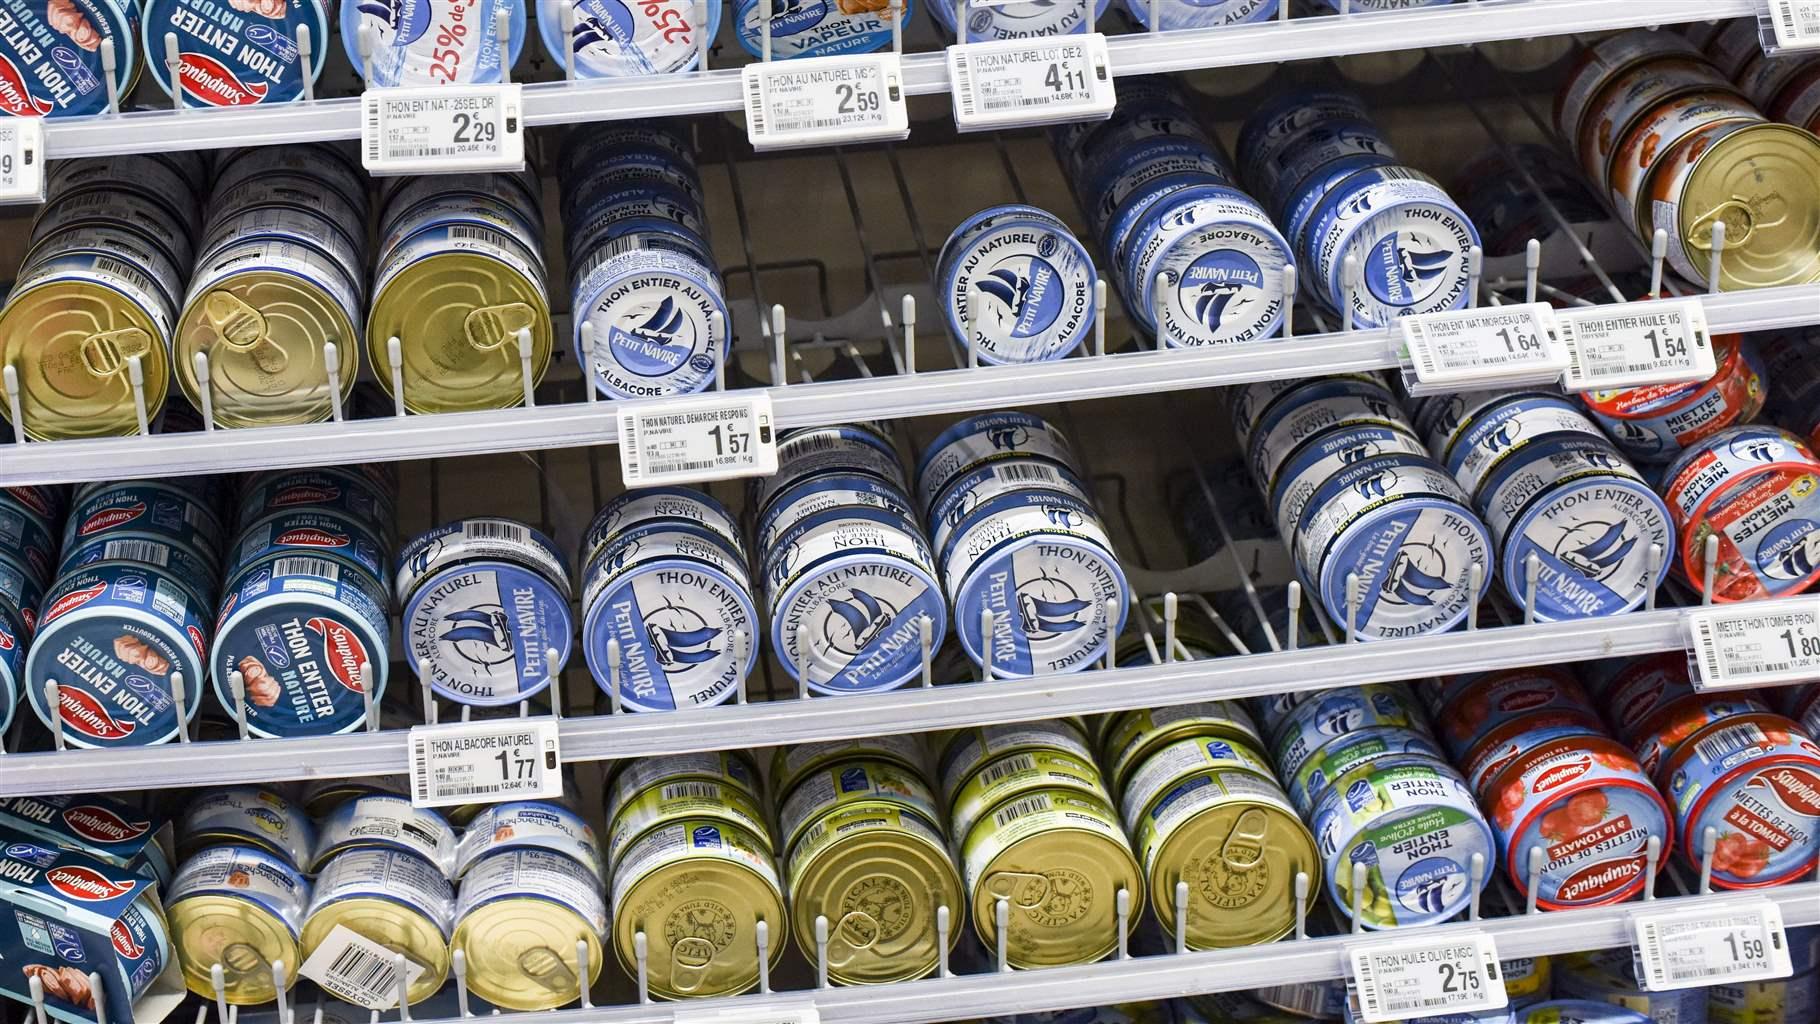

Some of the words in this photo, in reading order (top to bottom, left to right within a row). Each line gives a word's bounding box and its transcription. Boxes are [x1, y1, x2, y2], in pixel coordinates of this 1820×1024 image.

[783, 7, 823, 25] NAVIRE
[813, 18, 851, 34] THON
[170, 7, 241, 56] ENTIER
[791, 18, 882, 50] VAPEUR
[814, 34, 872, 57] NATURE
[237, 47, 286, 84] THON
[975, 56, 1000, 67] THON
[1001, 52, 1042, 64] NATUREL
[1062, 47, 1075, 59] DE
[34, 61, 76, 109] THON
[768, 75, 793, 87] THON
[796, 73, 808, 84] AU
[810, 70, 852, 83] NATUREL
[386, 101, 410, 113] THON
[482, 97, 495, 109] DR
[1199, 229, 1265, 245] ALBACORE
[1404, 208, 1441, 222] THON
[1441, 217, 1470, 254] ENTIER
[966, 256, 980, 275] AU
[978, 233, 1037, 257] NATUREL
[1381, 239, 1398, 264] PETIT
[1188, 265, 1230, 280] NAVIRE
[1229, 266, 1260, 282] PETIT
[1386, 264, 1405, 304] NAVIRE
[596, 286, 631, 315] THON
[631, 278, 681, 291] ENTIER
[681, 286, 701, 307] AU
[1016, 305, 1036, 335] PETIT
[1031, 265, 1052, 307] NAVIRE
[1058, 281, 1085, 344] ALBACORE
[1254, 298, 1281, 332] THON
[1580, 322, 1605, 334] THON
[1606, 317, 1638, 331] ENTIER
[1639, 314, 1666, 328] HUILE
[1667, 313, 1680, 324] 1/5
[1428, 323, 1451, 333] THON
[612, 332, 640, 354] PETIT
[639, 343, 681, 366] NAVIRE
[600, 368, 662, 397] ALBACORE
[642, 418, 660, 429] THON
[660, 415, 687, 427] NATUREL
[686, 411, 719, 424] DEMARCHE
[720, 408, 748, 420] RESPONS
[1664, 391, 1722, 428] MIETTES
[1671, 425, 1683, 436] DE
[1686, 408, 1718, 430] THON
[742, 454, 753, 464] Kg
[1682, 466, 1730, 513] MIETTES
[1684, 467, 1710, 497] THON
[1504, 479, 1548, 520] THON
[1542, 493, 1591, 521] THON
[1594, 488, 1644, 509] ENTIER
[1642, 508, 1661, 530] AU
[1774, 494, 1789, 508] DE
[1441, 513, 1476, 543] THON
[1609, 502, 1650, 534] ALBACORE
[1733, 500, 1795, 543] MIETTES
[1740, 504, 1774, 526] THON
[834, 537, 889, 550] THON
[968, 528, 1015, 562] THON
[1379, 519, 1409, 556] PETIT
[1037, 545, 1087, 564] THON
[1085, 558, 1118, 601] ENTIER
[425, 574, 482, 616] NATUREL
[655, 572, 708, 590] THON
[708, 584, 748, 629] ENTIER
[786, 588, 813, 632] ENTIER
[816, 570, 842, 592] AU
[842, 564, 916, 588] NATUREL
[806, 581, 849, 618] ALBACORE
[989, 572, 1009, 607] PETIT
[1554, 574, 1605, 618] NAVIRE
[414, 618, 428, 636] AU
[513, 587, 536, 638] NAVIRE
[1379, 611, 1448, 639] NATUREL
[1744, 618, 1766, 630] THON
[1795, 613, 1815, 625] PROV
[429, 616, 441, 660] ALBACORE
[612, 600, 638, 641] PETIT
[626, 641, 657, 699] NAVIRE
[991, 608, 1018, 664] NAVIRE
[70, 635, 126, 677] NATURE
[281, 617, 313, 660] THON
[300, 658, 335, 719] ENTIER
[522, 642, 542, 679] PETIT
[844, 648, 883, 686] PETIT
[57, 647, 118, 696] ENTIER
[281, 671, 314, 724] NATURE
[447, 677, 495, 697] THON
[113, 686, 156, 727] THON
[431, 741, 453, 754] THON
[454, 737, 497, 751] ALBACORE
[498, 734, 534, 749] NATUREL
[527, 780, 538, 790] Kg
[1391, 780, 1444, 792] ENTIER
[1535, 763, 1586, 792] Saupiquet
[1407, 787, 1449, 799] THON
[13, 800, 58, 825] THON
[66, 810, 132, 840] Saupiquet
[1414, 815, 1446, 836] Huile
[1732, 789, 1771, 821] MIETTES
[1770, 814, 1786, 832] DE
[1784, 822, 1810, 847] THON
[1392, 829, 1450, 855] ENTIER
[1552, 829, 1602, 859] TOMATE
[1595, 826, 1649, 854] MIETTES
[1748, 819, 1788, 848] TOMATE
[1407, 841, 1453, 861] THON
[1576, 849, 1592, 861] DE
[51, 870, 115, 900] Saupiquet
[1399, 870, 1433, 890] NAVIRE
[1564, 859, 1641, 901] Saupiquet
[1375, 956, 1400, 968] THON
[1401, 952, 1426, 966] HUILE
[1427, 949, 1452, 963] OLIVE
[1453, 946, 1474, 960] MSC
